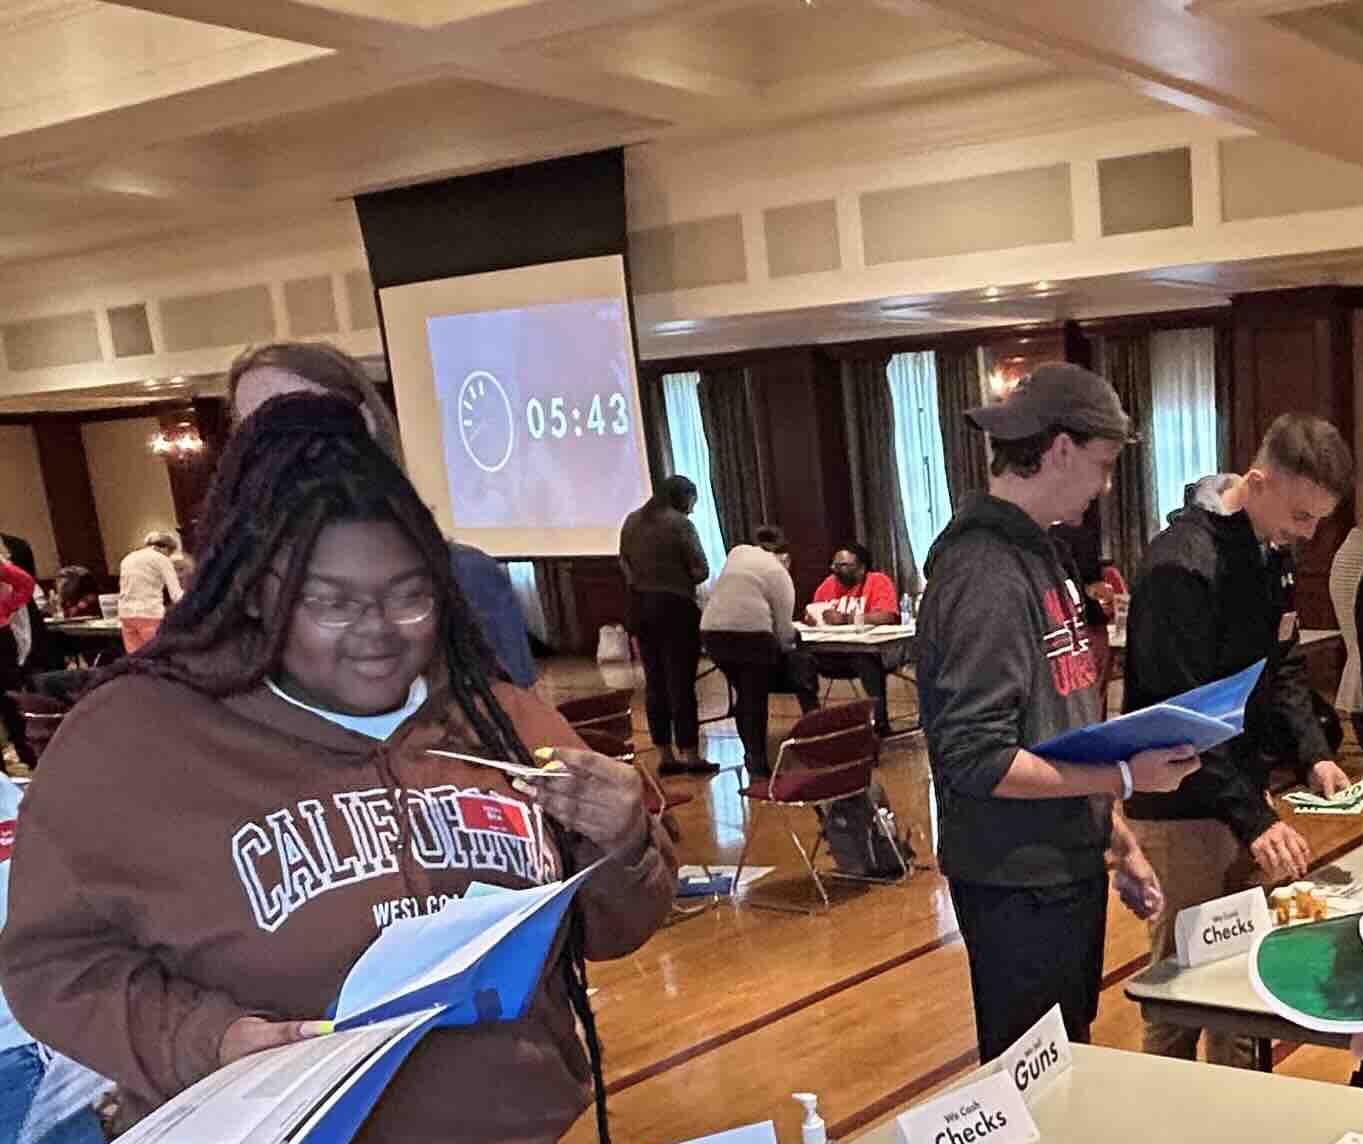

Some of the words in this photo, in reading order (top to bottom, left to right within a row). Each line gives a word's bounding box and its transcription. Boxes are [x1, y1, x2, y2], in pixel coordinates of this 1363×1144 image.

[527, 392, 629, 439] 05:43
[1203, 918, 1255, 945] Checks
[1014, 1041, 1059, 1092] Guns
